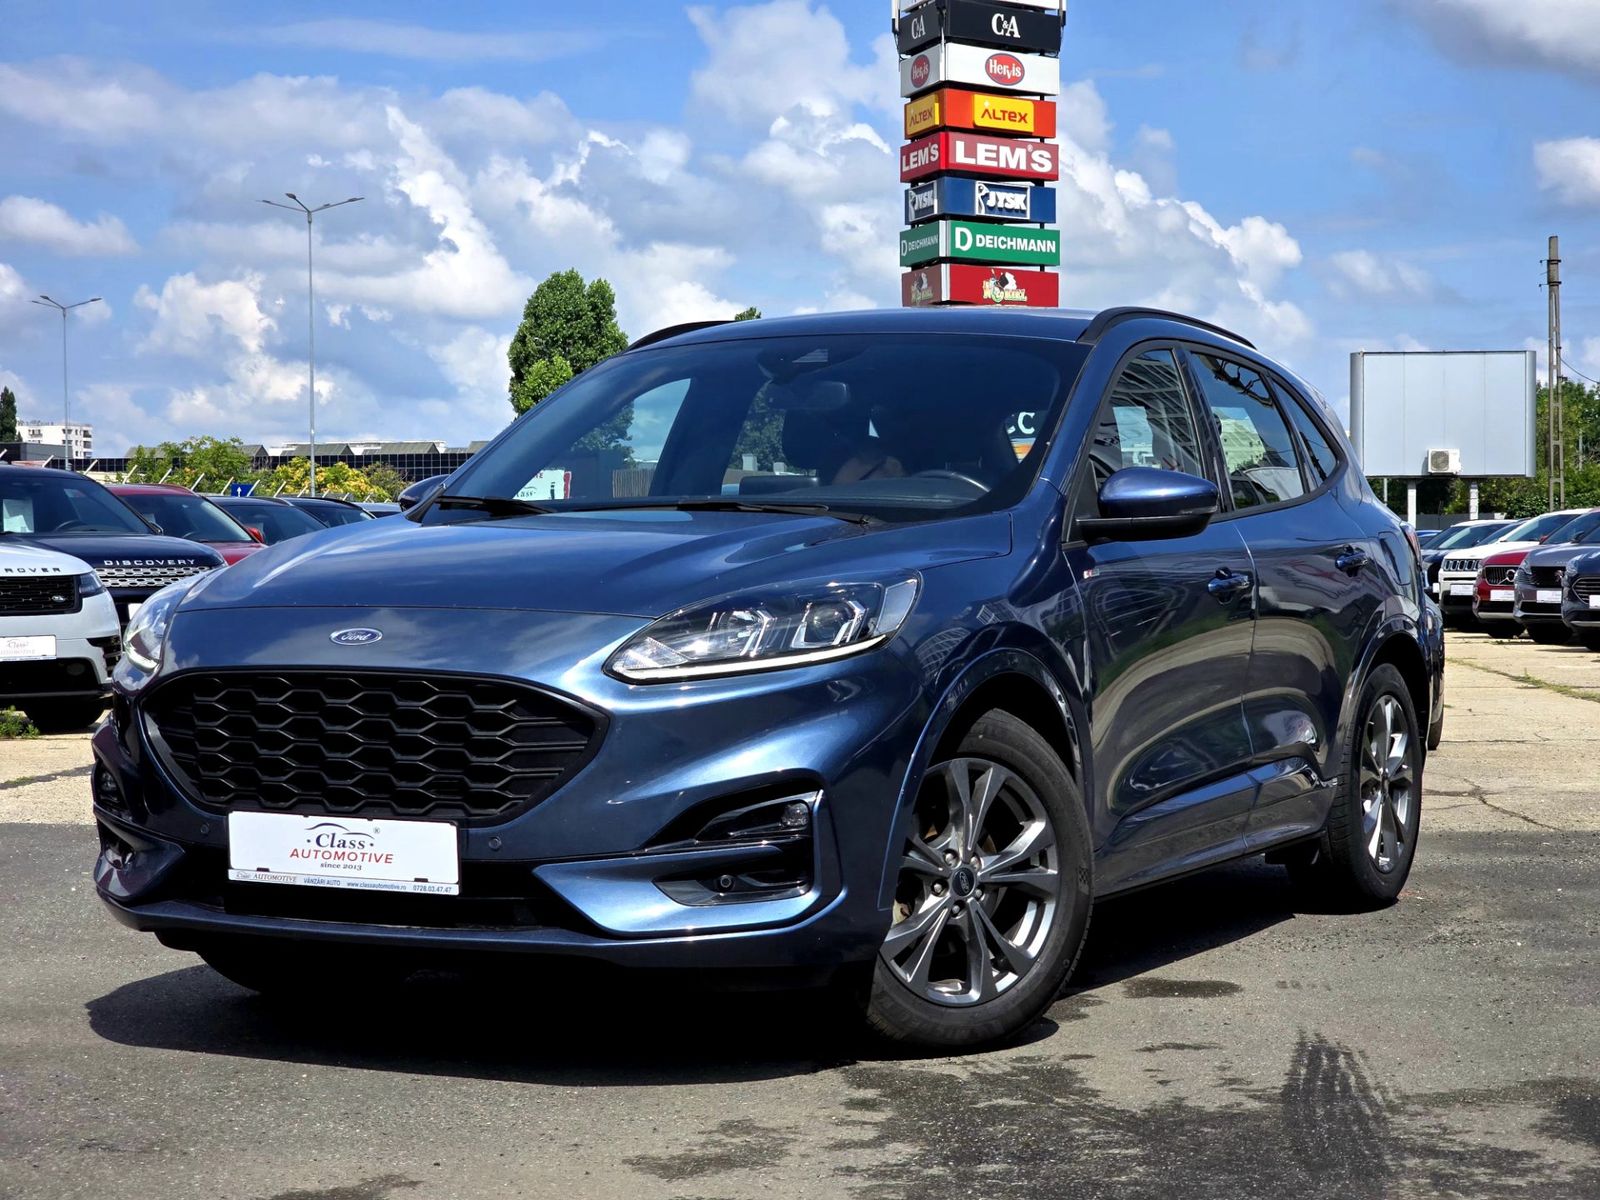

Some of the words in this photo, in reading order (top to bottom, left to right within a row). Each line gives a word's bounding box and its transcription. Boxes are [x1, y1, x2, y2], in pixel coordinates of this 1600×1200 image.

[991, 13, 1021, 38] C&A
[989, 59, 1022, 80] Hervis
[902, 143, 939, 172] LEM'S
[955, 140, 1053, 173] LEM'S
[914, 190, 934, 210] JYSK
[986, 190, 1028, 211] JYSK
[908, 234, 939, 251] DEICHMANN
[975, 234, 1056, 253] DEICHMANN
[4, 567, 62, 575] ROVER
[103, 558, 196, 567] DISCOVERY
[341, 631, 372, 641] Ford
[315, 832, 366, 850] Class
[289, 848, 394, 864] AUTOMOTIVE
[320, 861, 341, 869] since
[342, 863, 362, 871] 2013
[253, 873, 297, 883] AUTOMOTIVE
[347, 881, 406, 891] www.classautomotive.ro
